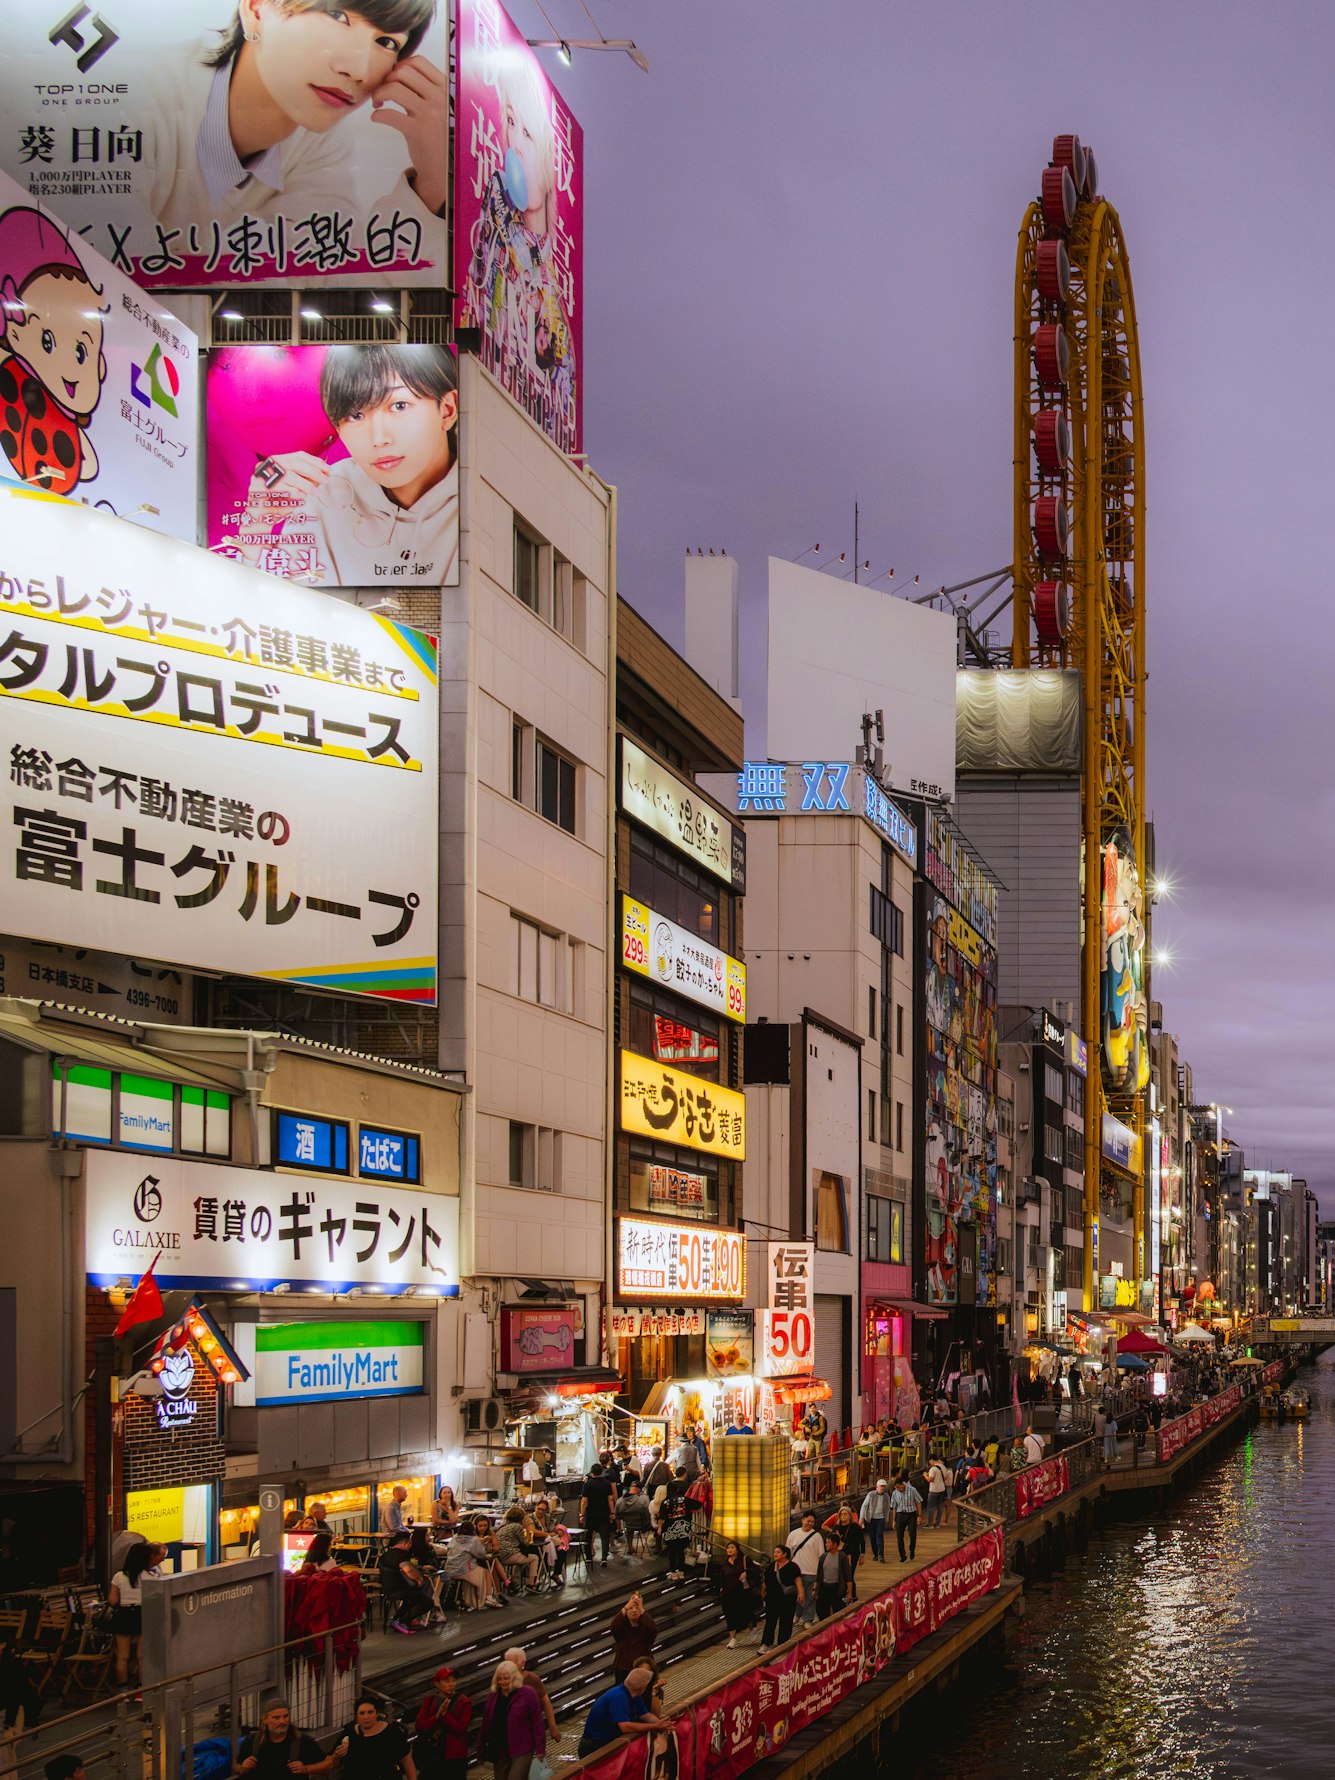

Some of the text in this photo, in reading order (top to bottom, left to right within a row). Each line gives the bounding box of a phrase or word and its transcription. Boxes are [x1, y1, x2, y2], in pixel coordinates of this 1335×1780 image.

[18, 124, 143, 164] 葵 日向
[121, 292, 190, 360] 総合不動産業の
[120, 398, 190, 460] 富士グループ
[10, 743, 290, 847] 総合不動産業の
[737, 761, 850, 811] 無双
[13, 805, 421, 948] 富士グループ
[28, 962, 94, 995] 日本橋支店
[675, 955, 724, 1000] 餃子のかっちゃん
[126, 987, 179, 1016] 4396-7000
[295, 1121, 316, 1162] 酒
[360, 1134, 403, 1174] たばこ
[193, 1191, 443, 1267] 賃貸のギャラント
[626, 1227, 667, 1266] 新時代
[679, 1233, 701, 1291] 50
[711, 1238, 740, 1292] 190
[773, 1247, 809, 1312] 伝串
[771, 1312, 812, 1358] 50
[288, 1352, 399, 1391] FamilyMart
[137, 1506, 180, 1521] RESTAURANT
[201, 1583, 254, 1607] information
